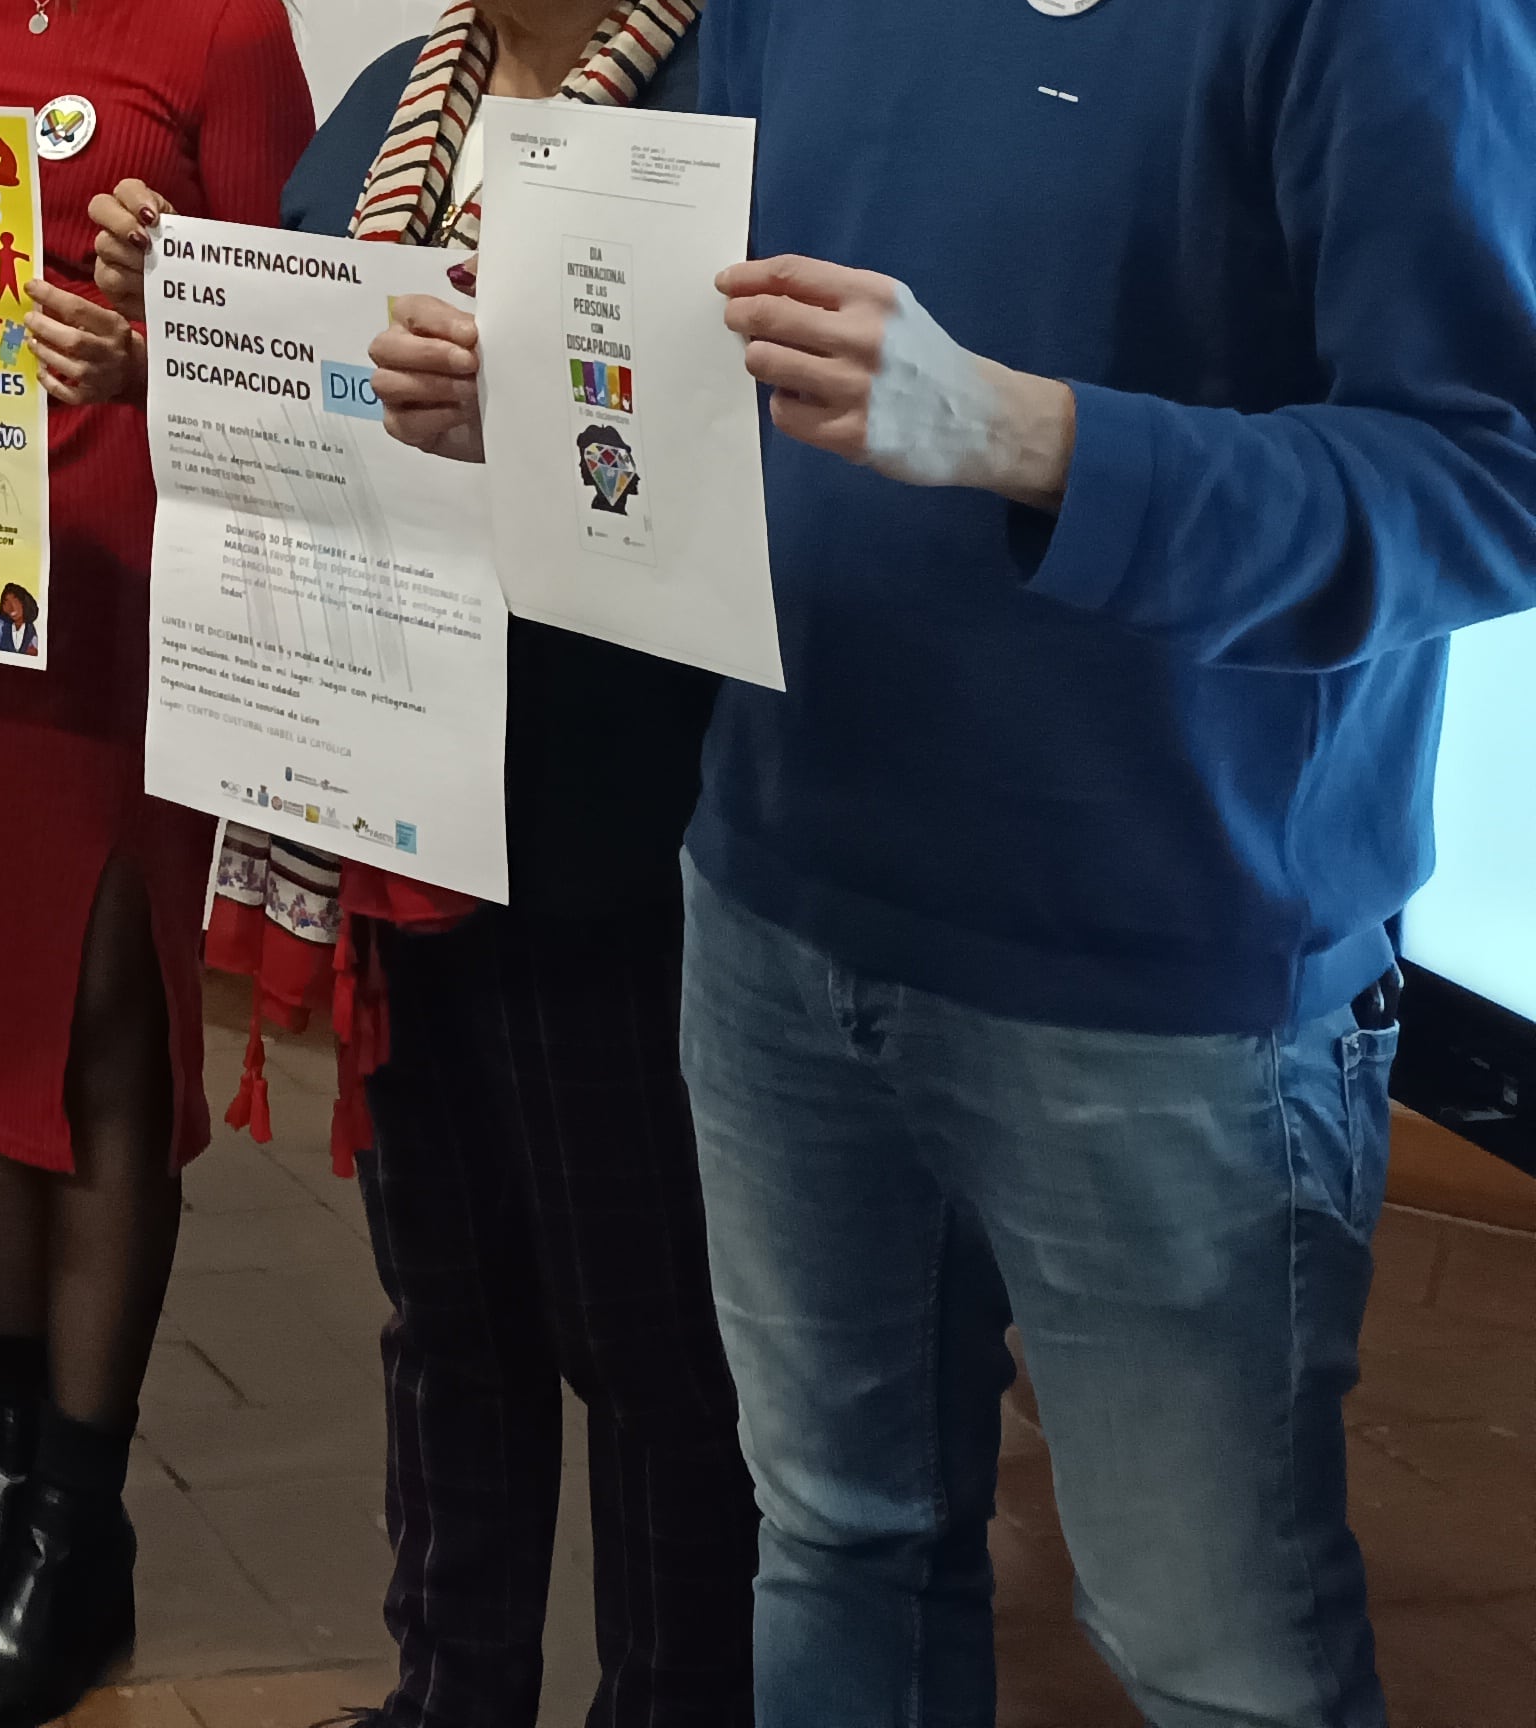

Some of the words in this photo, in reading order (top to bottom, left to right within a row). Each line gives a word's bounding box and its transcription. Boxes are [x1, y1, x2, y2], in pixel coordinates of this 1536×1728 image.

[163, 238, 195, 260] DIA
[201, 244, 362, 285] INTERNACIONAL
[589, 246, 603, 262] DIA
[567, 262, 626, 285] INTERNACIONAL
[164, 279, 187, 300] DE
[193, 285, 226, 307] LAS
[586, 283, 594, 296] DE
[595, 285, 607, 298] LAS
[573, 297, 621, 321] PERSONAS
[164, 320, 265, 355] PERSONAS
[271, 338, 314, 364] CON
[566, 333, 631, 361] DISCAPACIDAD
[166, 358, 311, 401] DISCAPACIDAD
